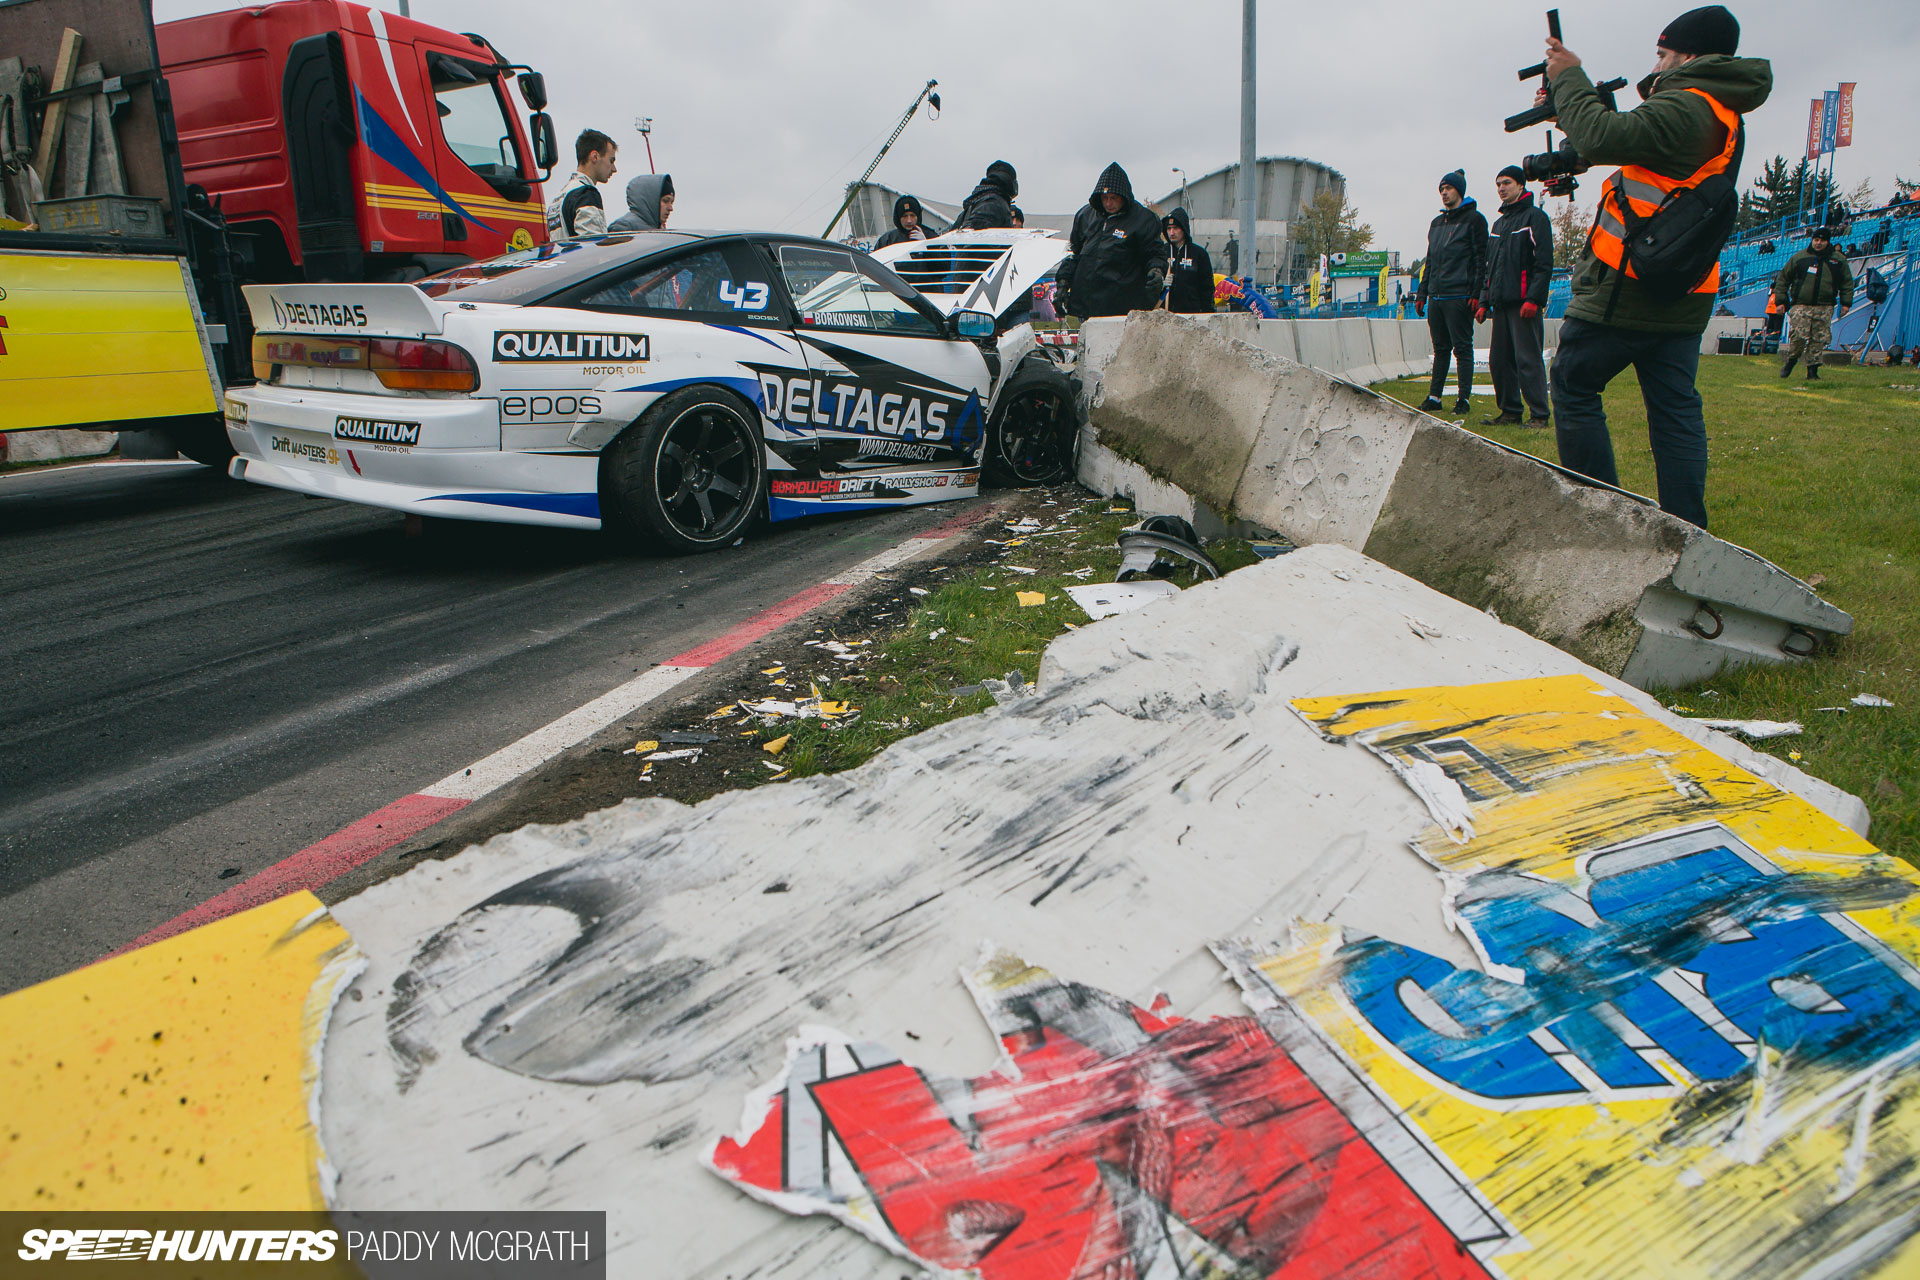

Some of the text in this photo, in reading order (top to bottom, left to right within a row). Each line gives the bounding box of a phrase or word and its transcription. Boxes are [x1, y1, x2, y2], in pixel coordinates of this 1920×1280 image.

[720, 280, 769, 311] 43
[285, 302, 368, 327] DELTAGAS
[815, 312, 868, 328] BORKOWSKI
[497, 333, 646, 358] QUALITIUM
[583, 366, 646, 376] MOTOR OIL
[503, 396, 602, 421] epos
[759, 373, 949, 440] DELTAGAS
[336, 418, 419, 443] QUALITIUM
[272, 436, 291, 453] Drift
[374, 444, 397, 453] MOTOR
[858, 438, 937, 462] WWW.DELTAGAS.PL
